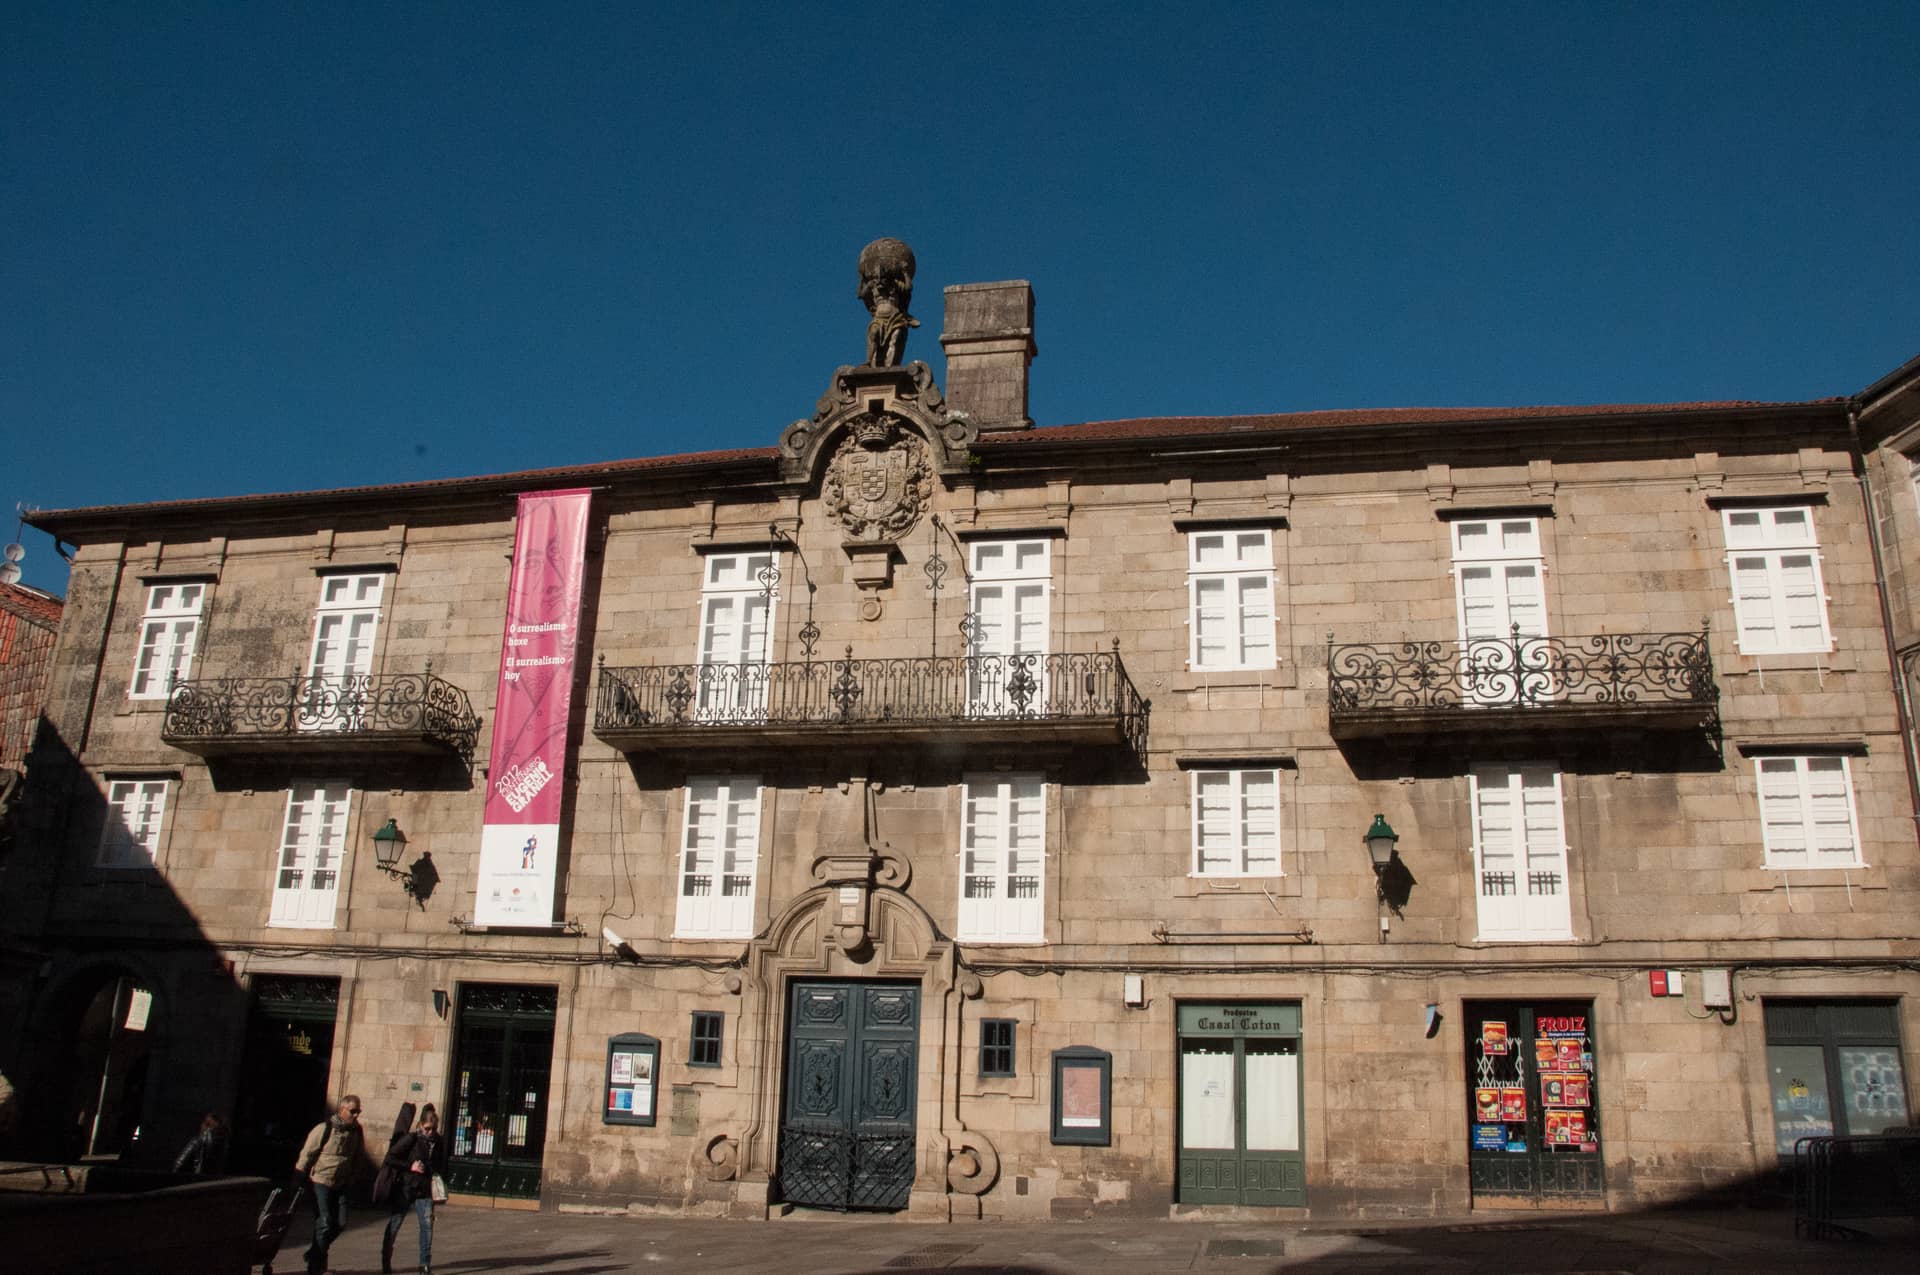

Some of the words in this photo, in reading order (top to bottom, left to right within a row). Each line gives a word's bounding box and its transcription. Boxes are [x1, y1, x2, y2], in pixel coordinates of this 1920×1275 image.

[510, 623, 516, 634] O
[516, 621, 567, 633] surrealismo
[508, 636, 529, 647] hoxe
[506, 656, 515, 667] El
[516, 655, 566, 667] surrealismo
[504, 670, 521, 682] hoy
[495, 764, 520, 794] 2012
[505, 761, 547, 807] EUGENIO
[511, 772, 555, 813] GRANELL
[1198, 1017, 1235, 1031] Casal
[1537, 1016, 1586, 1032] FROIZ
